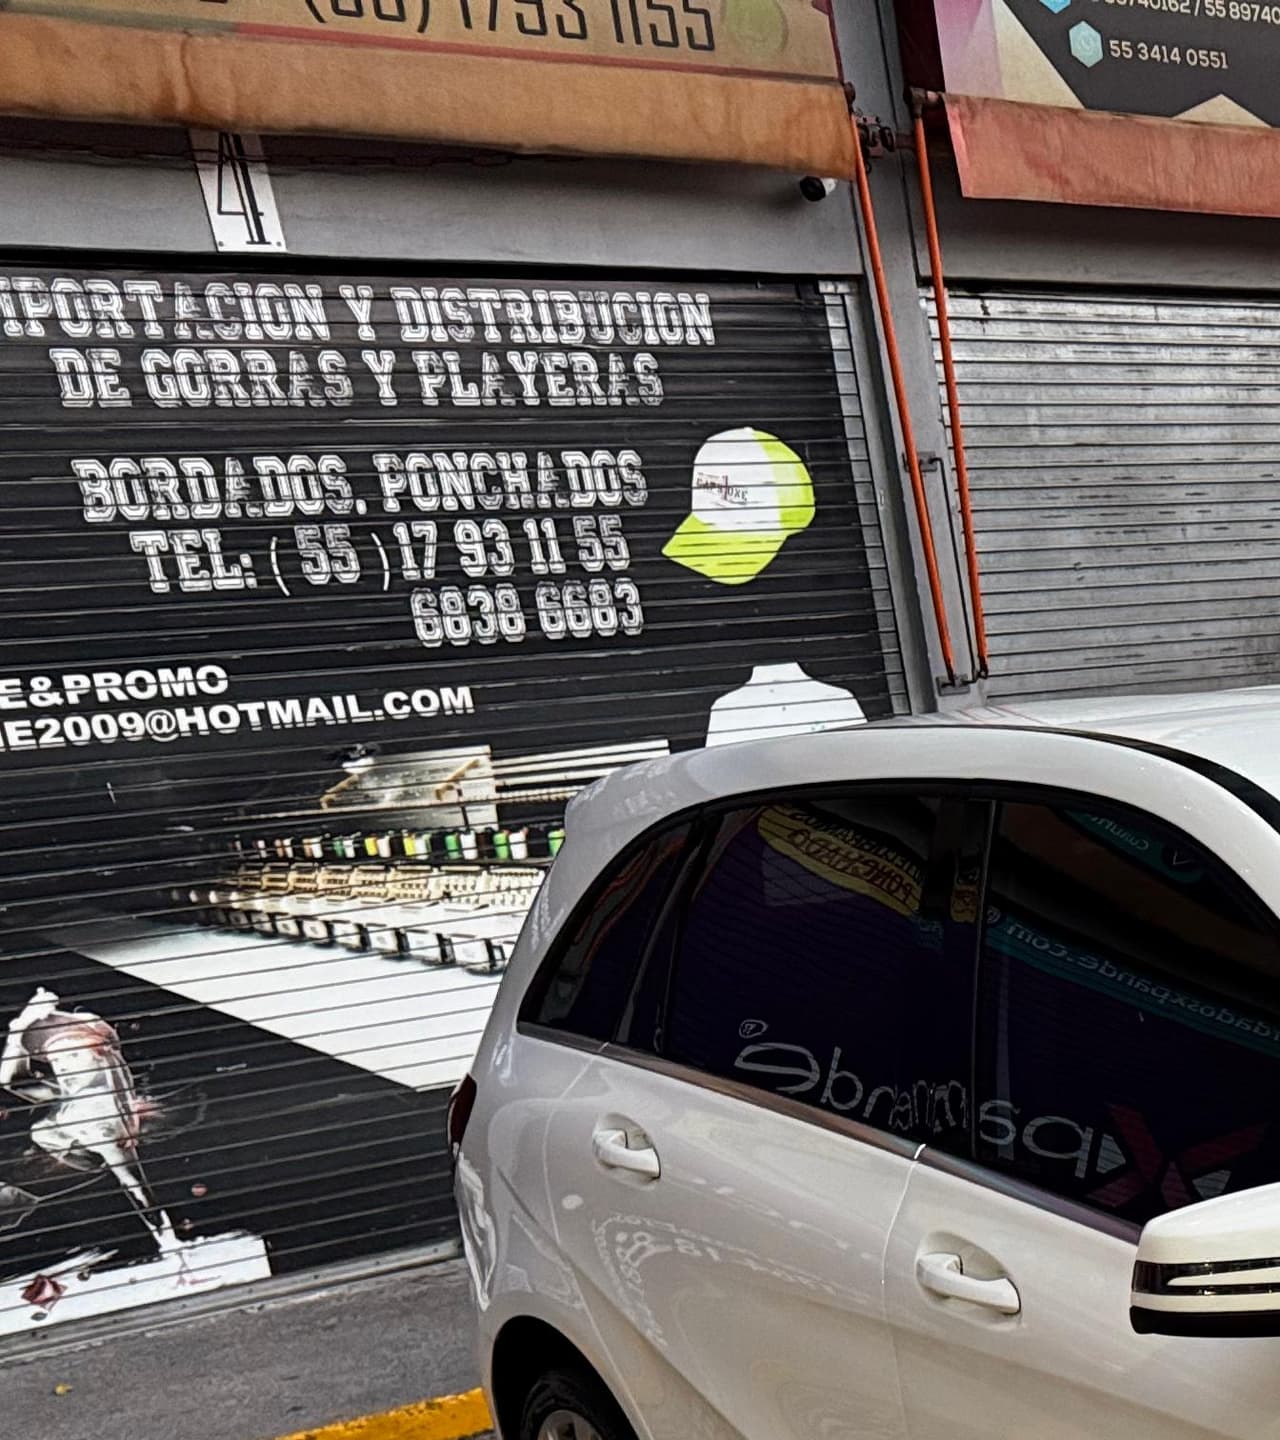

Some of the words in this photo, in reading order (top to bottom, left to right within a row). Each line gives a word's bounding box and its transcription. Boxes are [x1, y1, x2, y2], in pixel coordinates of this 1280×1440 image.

[1204, 0, 1227, 18] 55
[1108, 39, 1133, 59] 55
[1138, 42, 1182, 65] 3414
[1186, 49, 1229, 70] 0551
[217, 130, 272, 245] 4
[340, 284, 376, 342] Y
[390, 286, 715, 346] DISTRIBUCION
[49, 348, 133, 408] DE
[140, 348, 354, 409] GORRAS
[361, 350, 398, 407] Y
[411, 351, 665, 408] PLAYERAS
[372, 449, 649, 514] PONCHADOS
[128, 527, 258, 593] TEL:
[393, 519, 438, 581] 17
[453, 518, 516, 578] 93
[522, 516, 567, 575] 11
[572, 514, 632, 573] 55
[410, 582, 528, 648] 6838
[535, 577, 645, 641] 6683
[0, 686, 476, 754] E2009@HOTMAIL.COM
